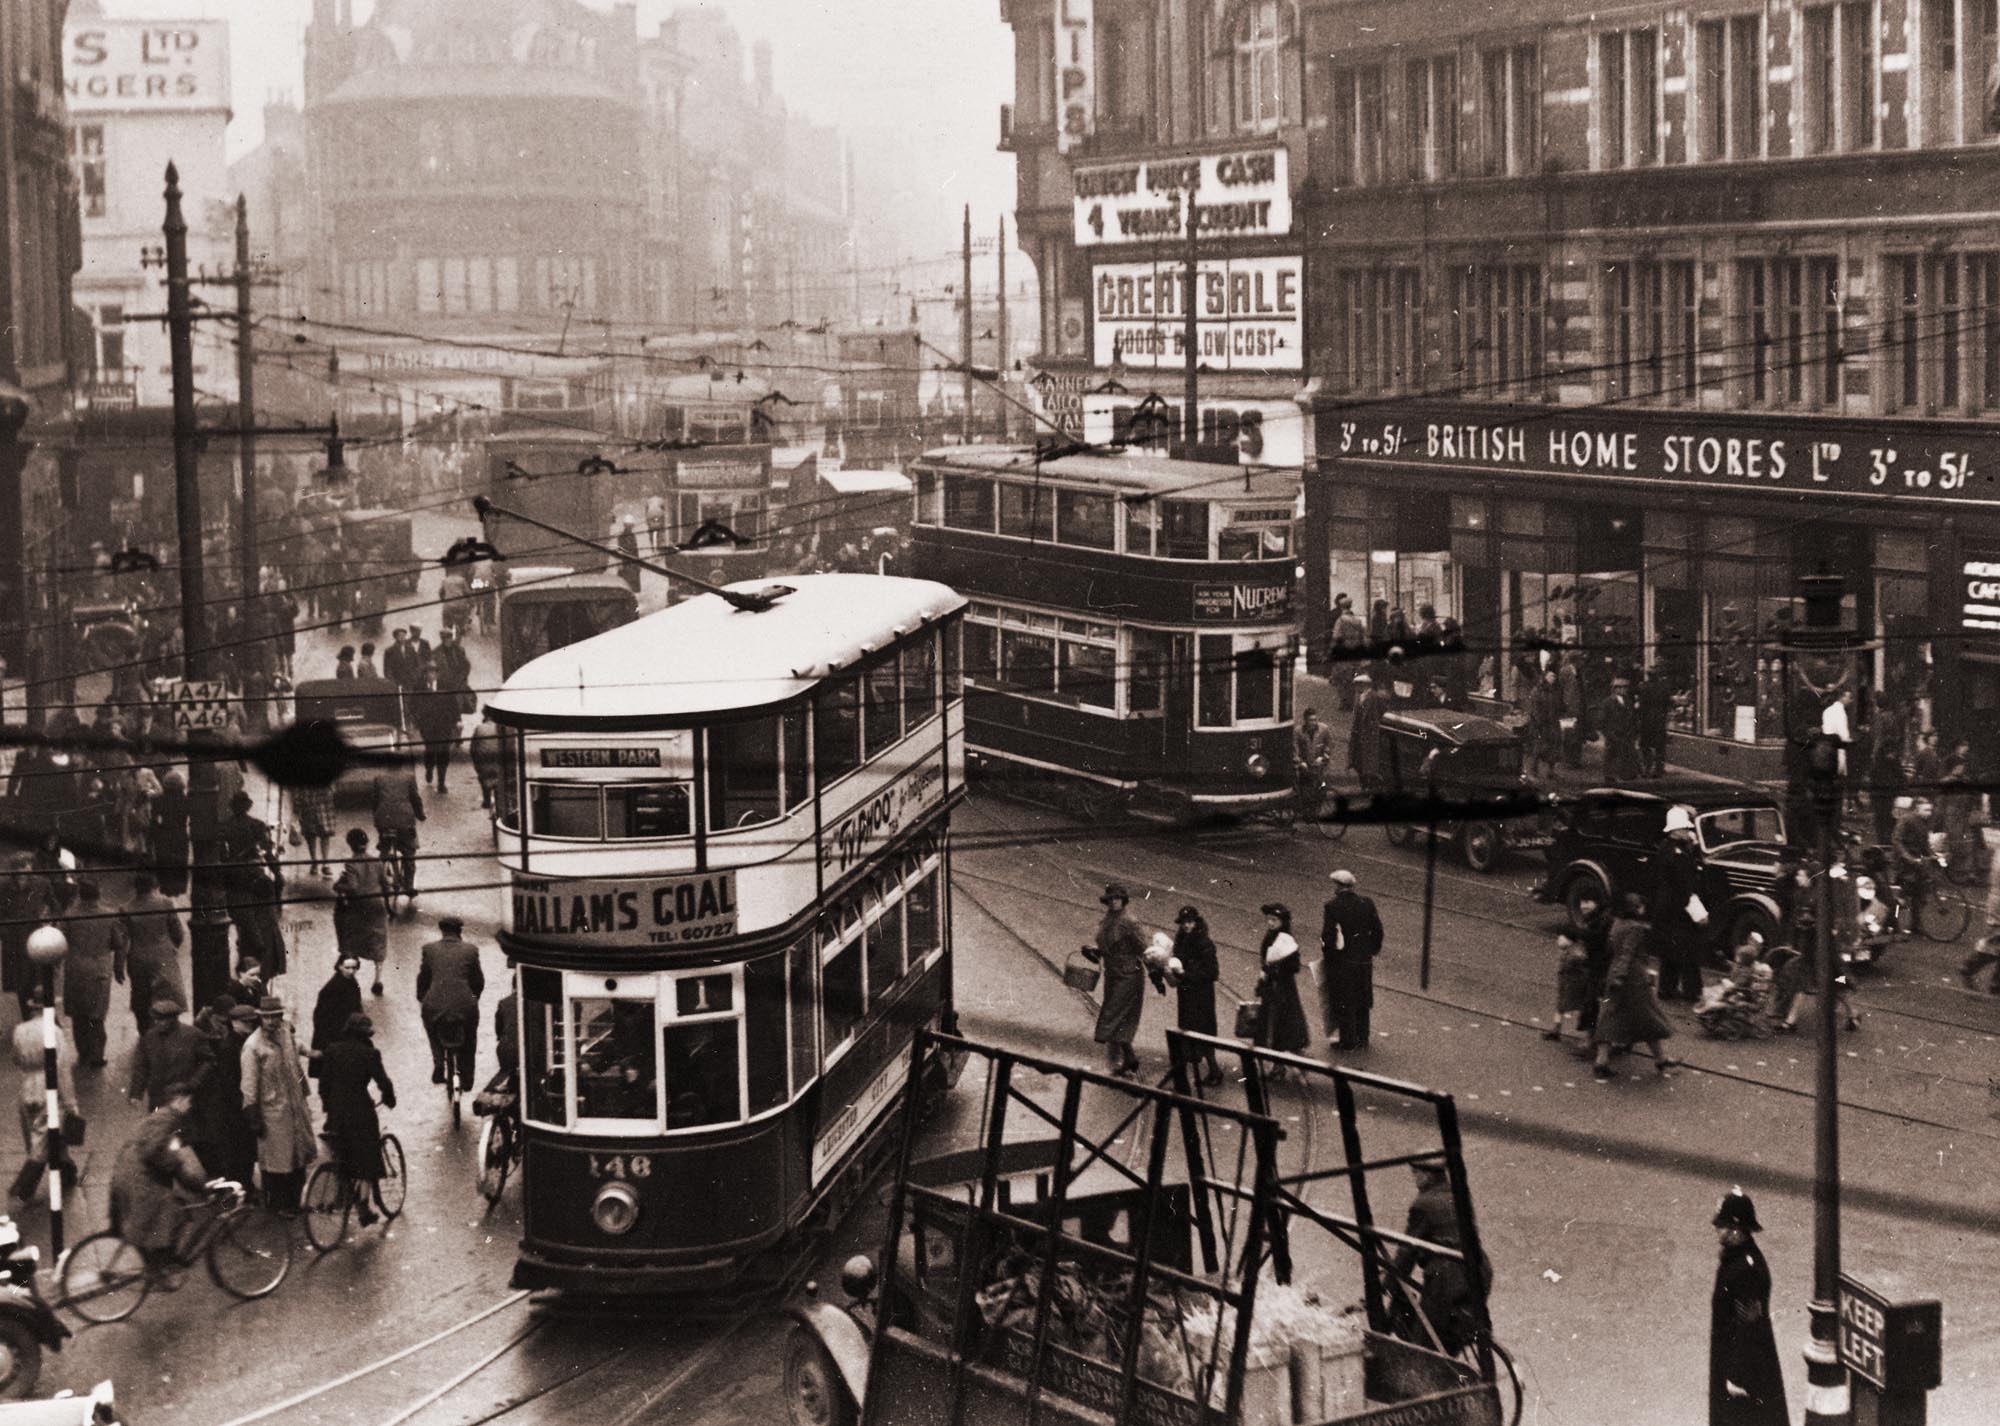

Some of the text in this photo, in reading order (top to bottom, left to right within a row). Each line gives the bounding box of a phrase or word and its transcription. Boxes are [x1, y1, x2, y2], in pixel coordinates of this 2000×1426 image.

[1216, 152, 1276, 188] CASH
[1087, 204, 1104, 236] 4
[1099, 269, 1297, 315] GREAT SALE
[1234, 327, 1277, 357] COST
[1427, 424, 1526, 461] BRITISH
[1549, 430, 1638, 470] HOME
[1663, 435, 1786, 479] STORES
[1903, 470, 1932, 488] TO
[179, 684, 222, 700] A47
[179, 711, 223, 726] A46
[546, 749, 658, 766] WESTERN PARK
[513, 875, 735, 935] HALLAM'S COAL
[681, 922, 734, 940] 60727
[695, 978, 710, 1010] 1
[1840, 1289, 1885, 1340] KEEP
[1840, 1325, 1885, 1377] LEFT
